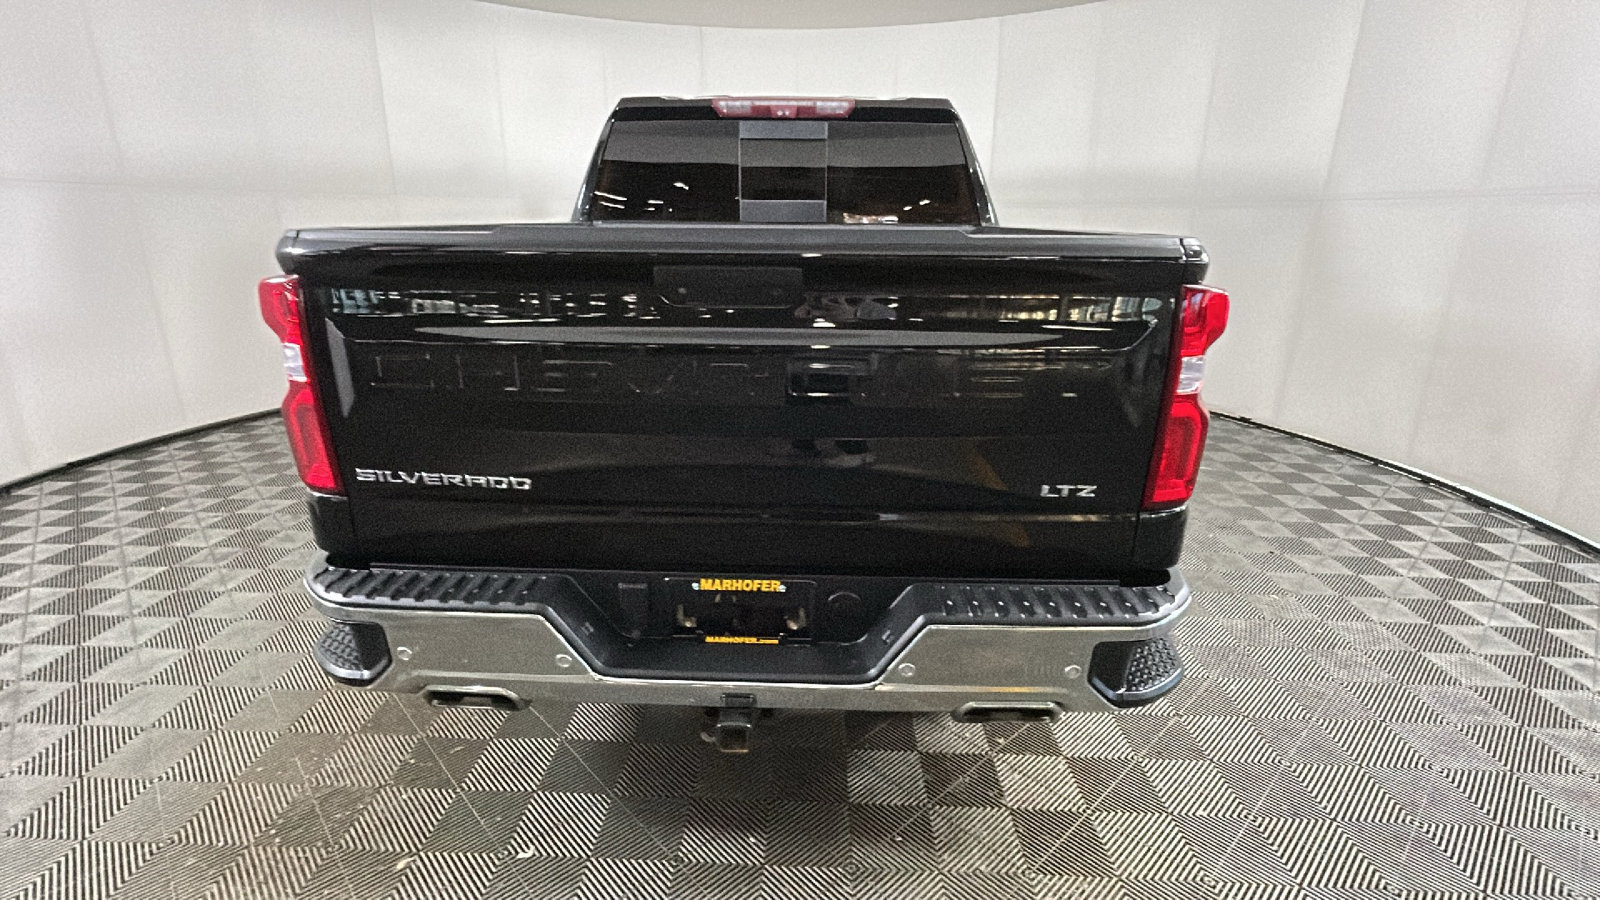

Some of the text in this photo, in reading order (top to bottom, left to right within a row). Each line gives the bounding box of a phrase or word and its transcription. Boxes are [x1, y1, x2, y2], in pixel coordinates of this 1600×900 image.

[355, 467, 532, 490] SILVERADO
[1040, 484, 1098, 498] LTZ
[700, 578, 781, 592] MARHOFER
